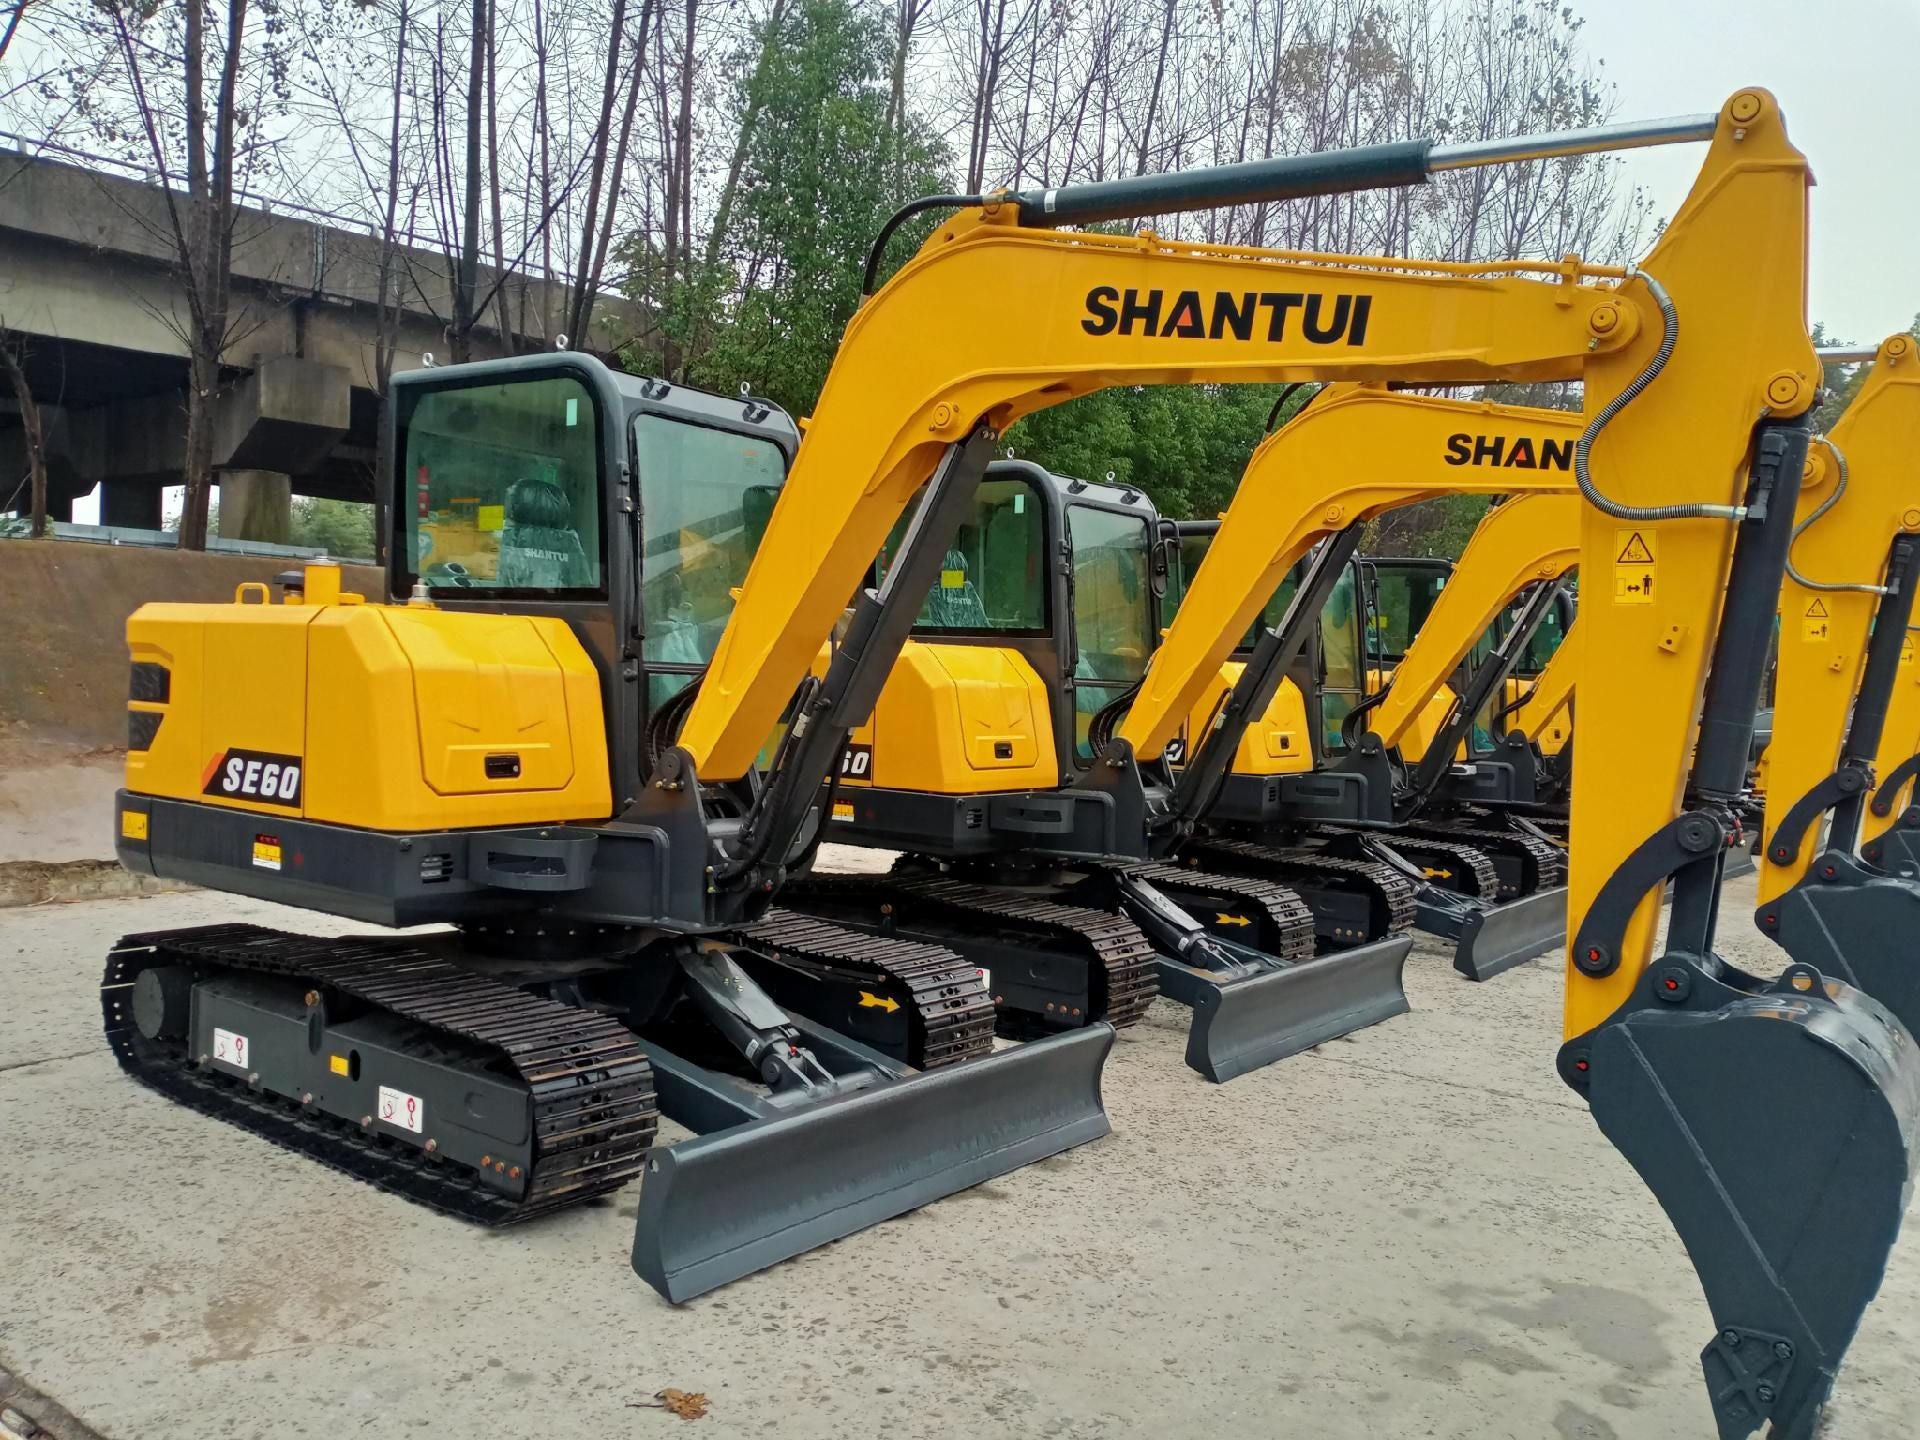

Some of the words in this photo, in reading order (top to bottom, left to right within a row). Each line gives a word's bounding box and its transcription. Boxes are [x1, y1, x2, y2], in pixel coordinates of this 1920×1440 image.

[1081, 286, 1372, 346] SHANTUI
[1444, 433, 1581, 471] SHAN
[222, 757, 300, 799] SE60
